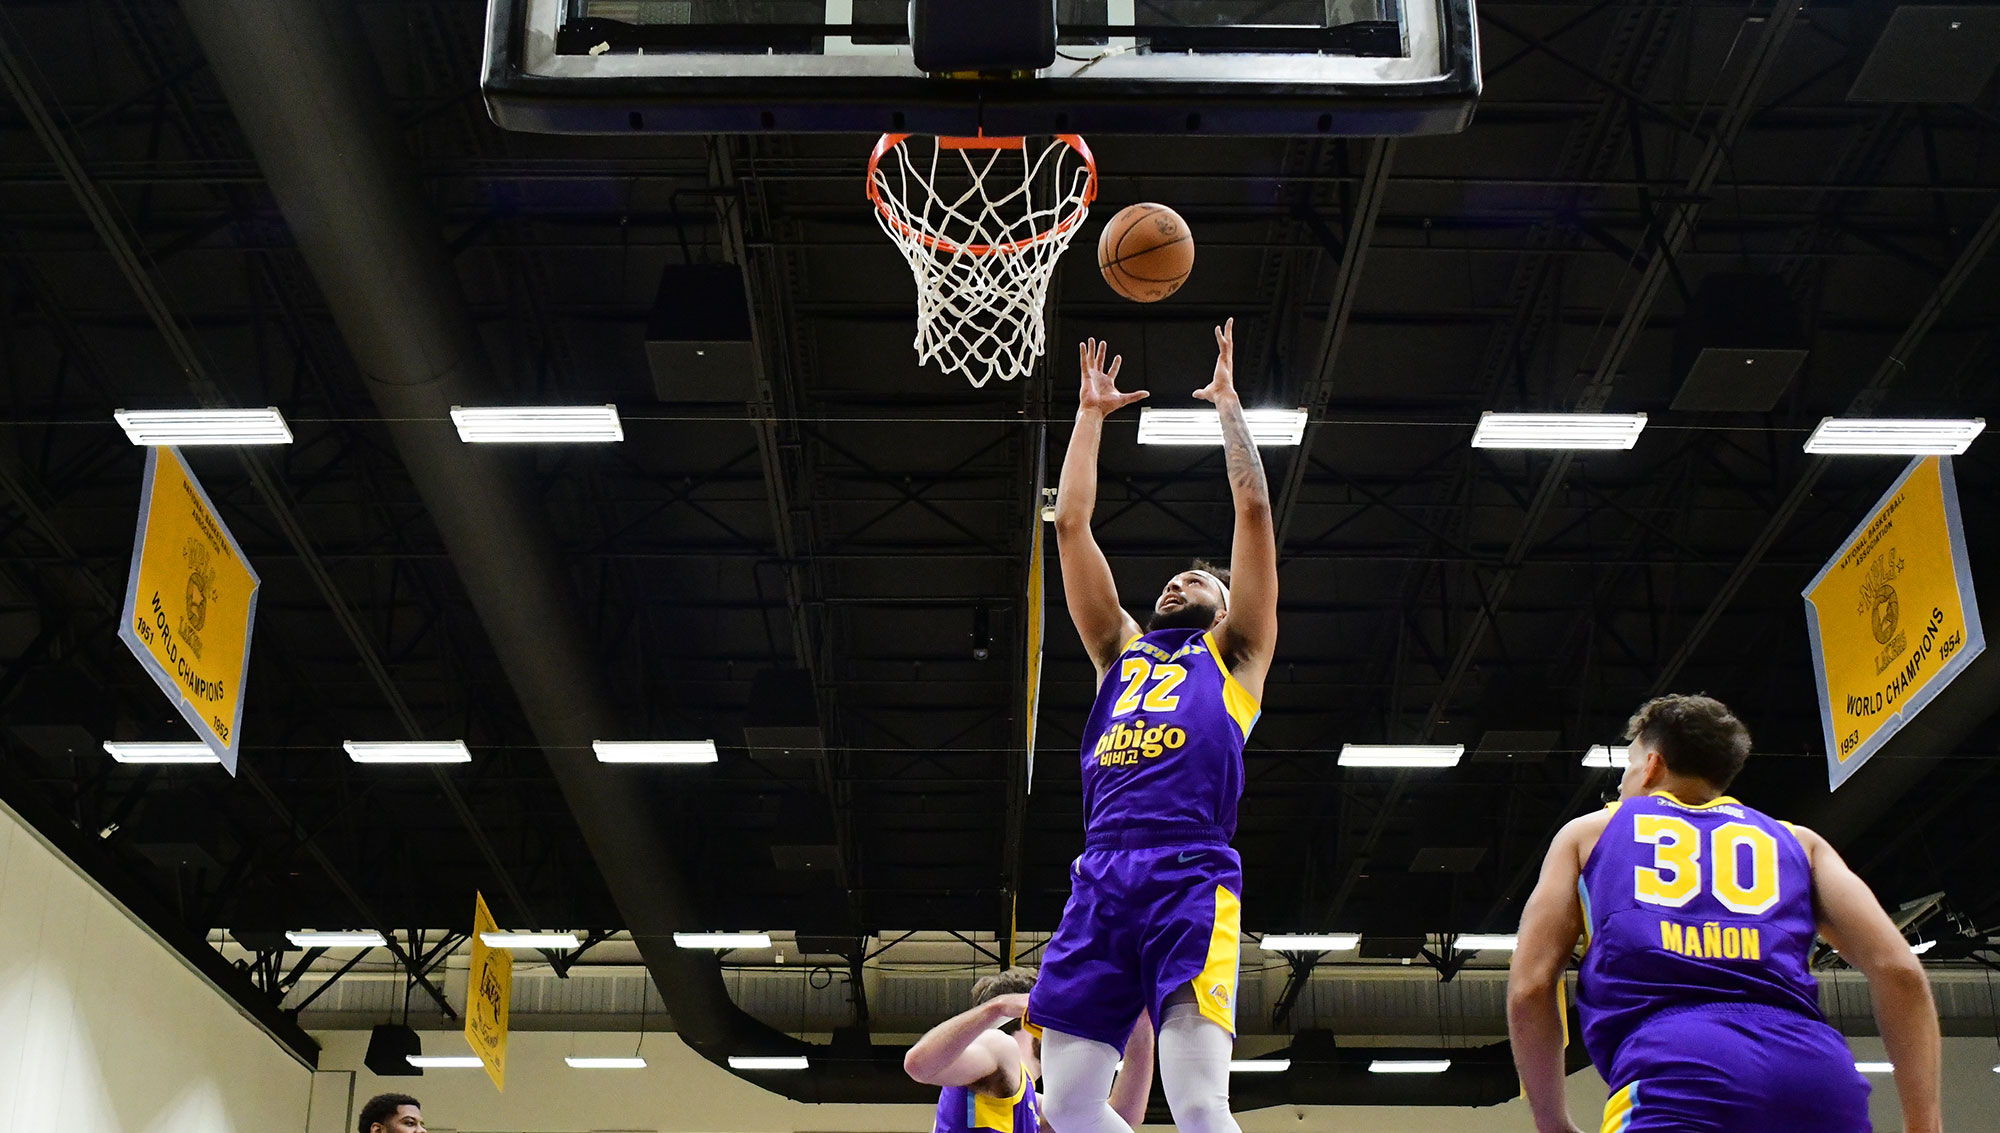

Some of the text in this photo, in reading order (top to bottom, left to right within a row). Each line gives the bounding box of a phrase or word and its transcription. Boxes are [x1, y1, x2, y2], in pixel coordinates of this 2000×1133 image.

[1841, 493, 1906, 568] NATIONAL BASKETBALL
[1856, 519, 1893, 566] ASSOCIATION
[138, 617, 154, 645] 1951
[152, 591, 224, 702] WORLD CHAMPIONS
[1939, 630, 1961, 661] 1954
[1846, 607, 1944, 717] WORLD CHAMPIONS
[1112, 656, 1188, 718] 22
[213, 715, 229, 741] 1952
[1093, 720, 1186, 758] bibigo
[1840, 730, 1859, 755] 1953
[1100, 749, 1139, 767] 비비고
[1634, 813, 1780, 915] 30
[1660, 921, 1760, 960] MAÑON
